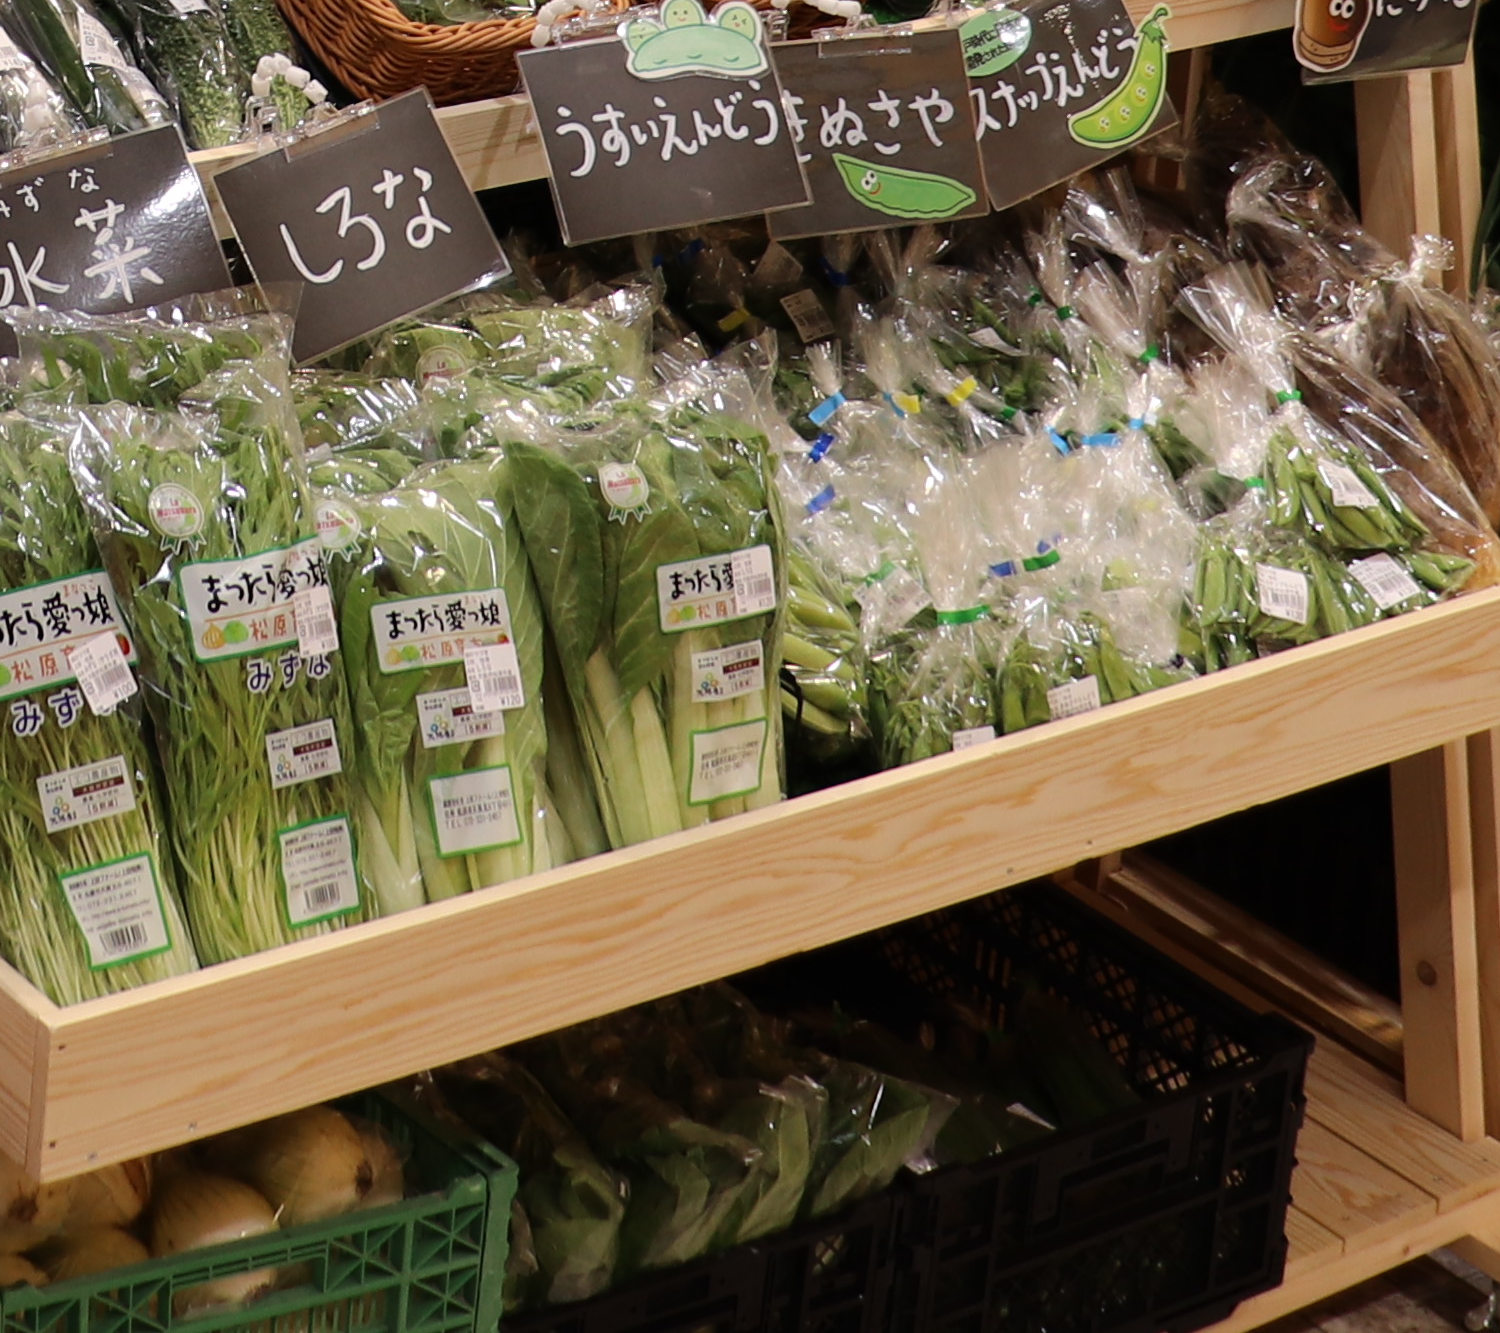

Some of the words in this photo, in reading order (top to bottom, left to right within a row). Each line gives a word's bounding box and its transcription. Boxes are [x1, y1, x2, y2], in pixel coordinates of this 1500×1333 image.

[555, 78, 780, 179] うすいえんどう
[279, 167, 452, 285] しろな
[249, 610, 298, 641] 松原
